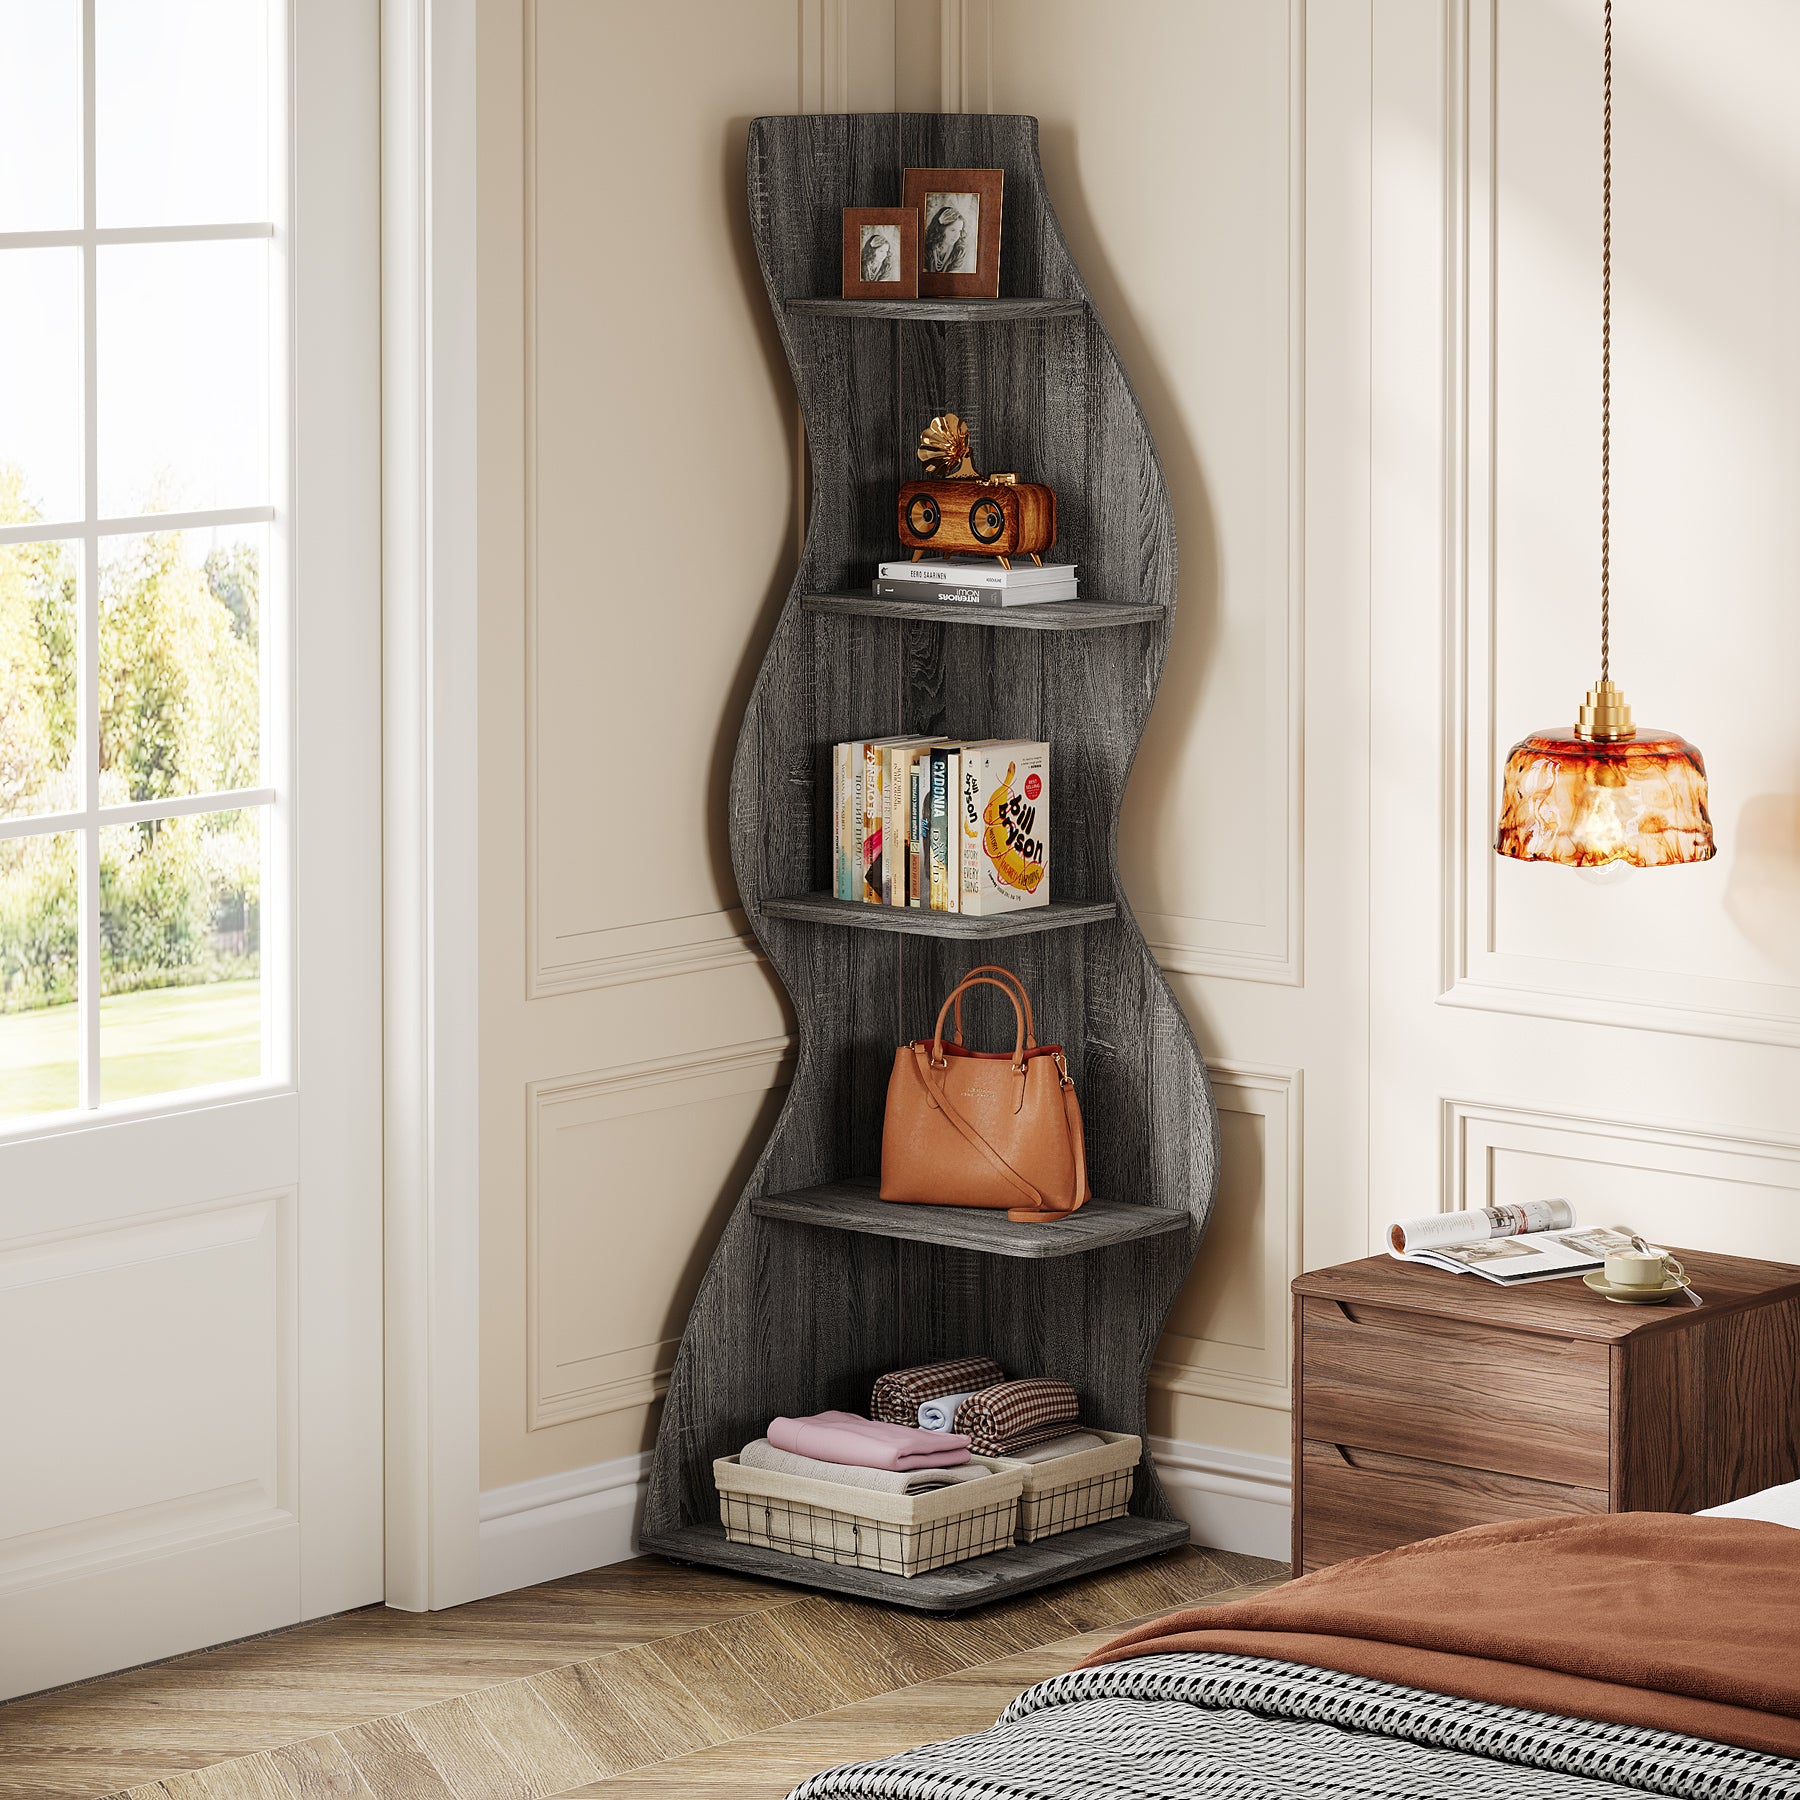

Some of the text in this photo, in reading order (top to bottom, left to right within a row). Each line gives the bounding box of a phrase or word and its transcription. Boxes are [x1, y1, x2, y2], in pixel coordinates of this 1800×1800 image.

[910, 570, 947, 580] EERO SAARINEN
[938, 593, 980, 603] INTERIORS
[855, 775, 863, 825] ПОНТИЙ
[883, 782, 891, 814] AFTER
[933, 761, 945, 818] CYDONIA
[964, 772, 978, 823] bryson
[971, 778, 979, 794] bill
[998, 802, 1043, 864] bryson
[1009, 794, 1036, 835] bill
[932, 829, 940, 884] DAVID
[963, 866, 979, 880] EVERY
